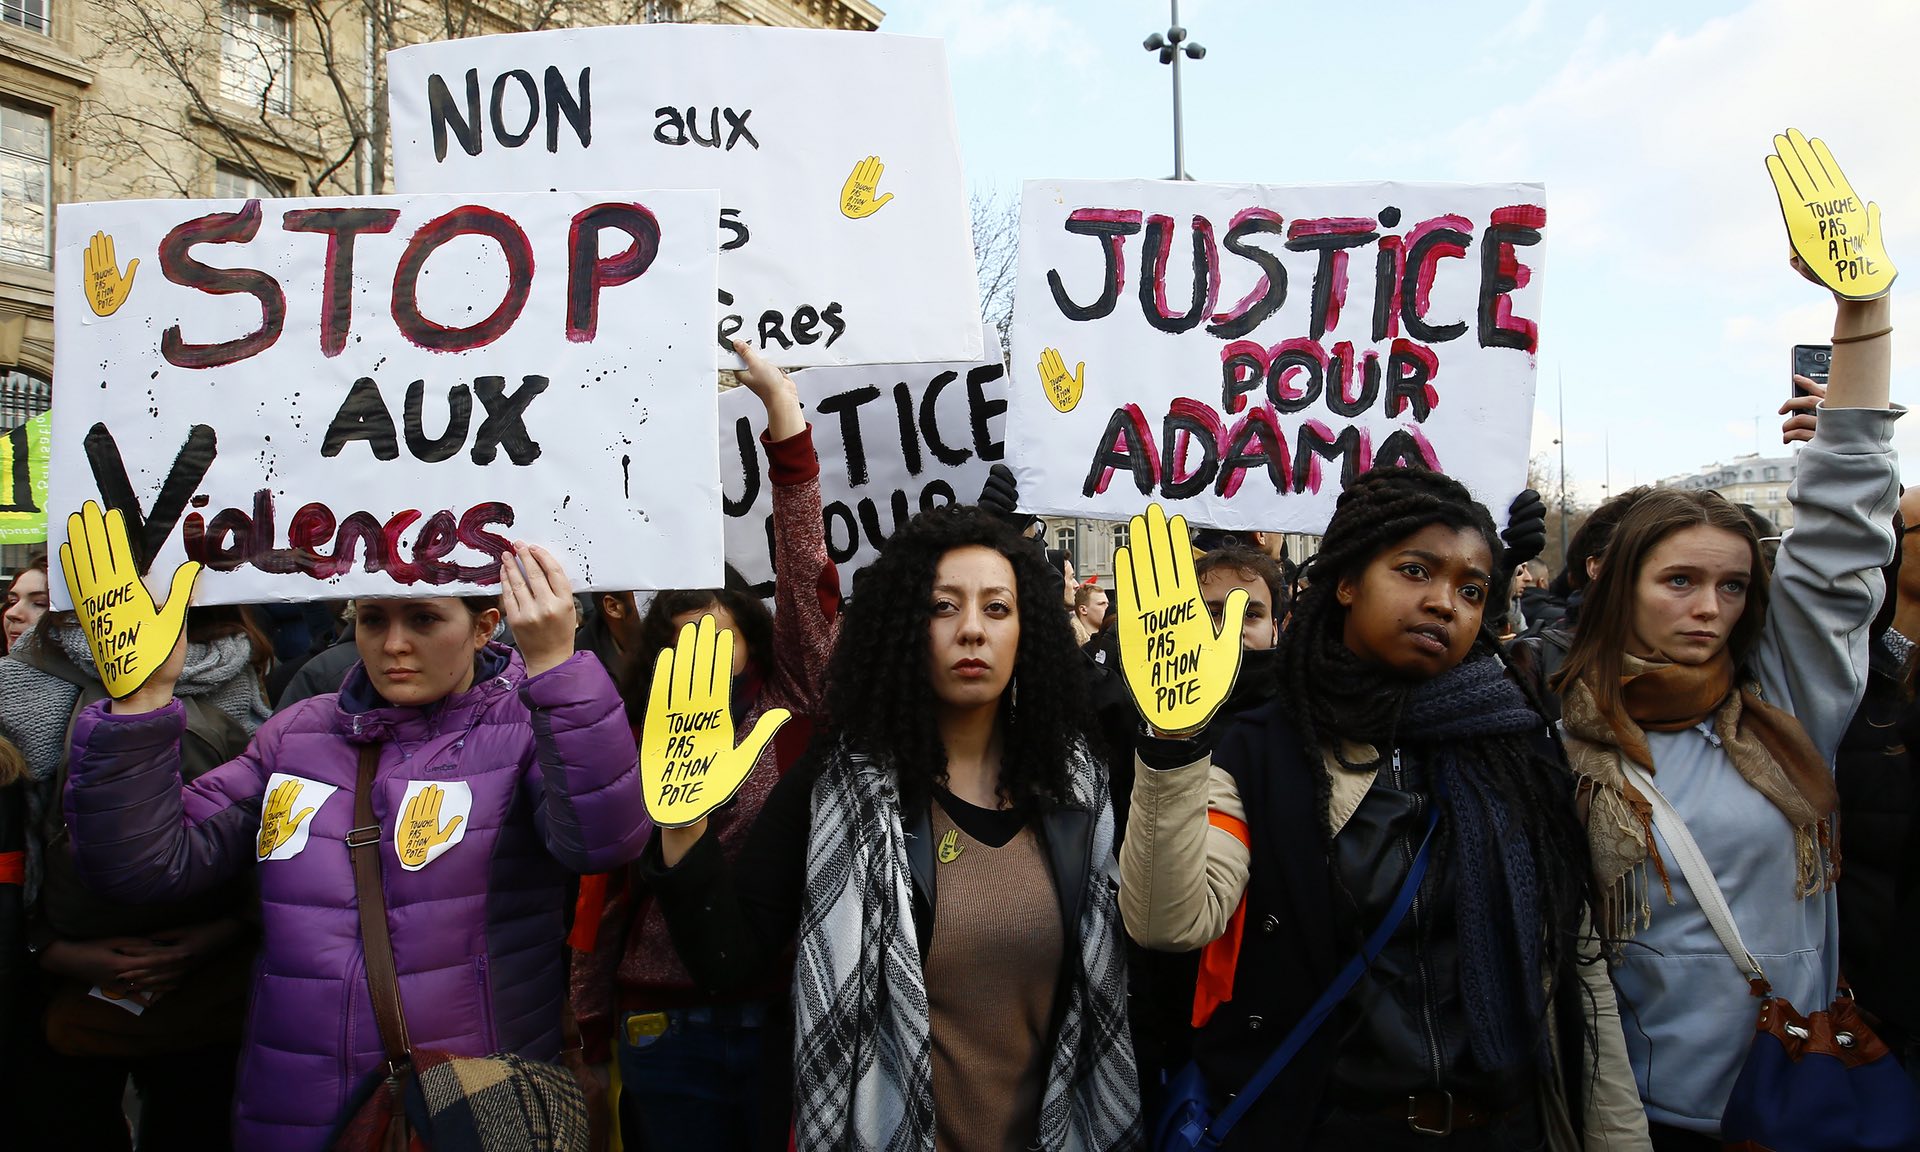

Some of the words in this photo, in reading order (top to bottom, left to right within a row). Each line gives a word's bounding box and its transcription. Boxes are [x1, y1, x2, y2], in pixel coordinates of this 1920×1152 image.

[428, 65, 592, 163] NON
[652, 105, 760, 151] aux
[1804, 197, 1857, 219] TOUCHE
[1819, 218, 1846, 240] PAS
[1829, 240, 1838, 261] A
[92, 267, 114, 280] TOUCHE
[1046, 203, 1547, 356] JUSTICE
[1835, 256, 1879, 282] POTE
[95, 280, 106, 290] PAS
[101, 283, 115, 298] MON
[158, 199, 660, 369] STOP
[97, 298, 113, 310] POTE
[1221, 337, 1439, 424] POUR
[321, 375, 549, 465] AUX
[84, 421, 516, 585] Violences
[82, 581, 135, 618] TOUCHE
[91, 613, 112, 641] PAS
[1138, 598, 1197, 635] TOUCHE
[98, 641, 105, 663] A
[105, 621, 141, 658] MON
[1147, 631, 1175, 662] PAS
[104, 651, 138, 684] POTE
[1152, 662, 1160, 687] A
[1166, 643, 1201, 683] MON
[1155, 678, 1201, 713] POTE
[666, 709, 723, 734] TOUCHE
[665, 736, 695, 759] PAS
[661, 761, 675, 782] A
[675, 752, 718, 781] MON
[658, 782, 703, 806] POTE
[408, 829, 422, 839] PAS
[410, 818, 435, 829] TOUCHE
[404, 847, 425, 858] POTE
[412, 835, 431, 847] MON
